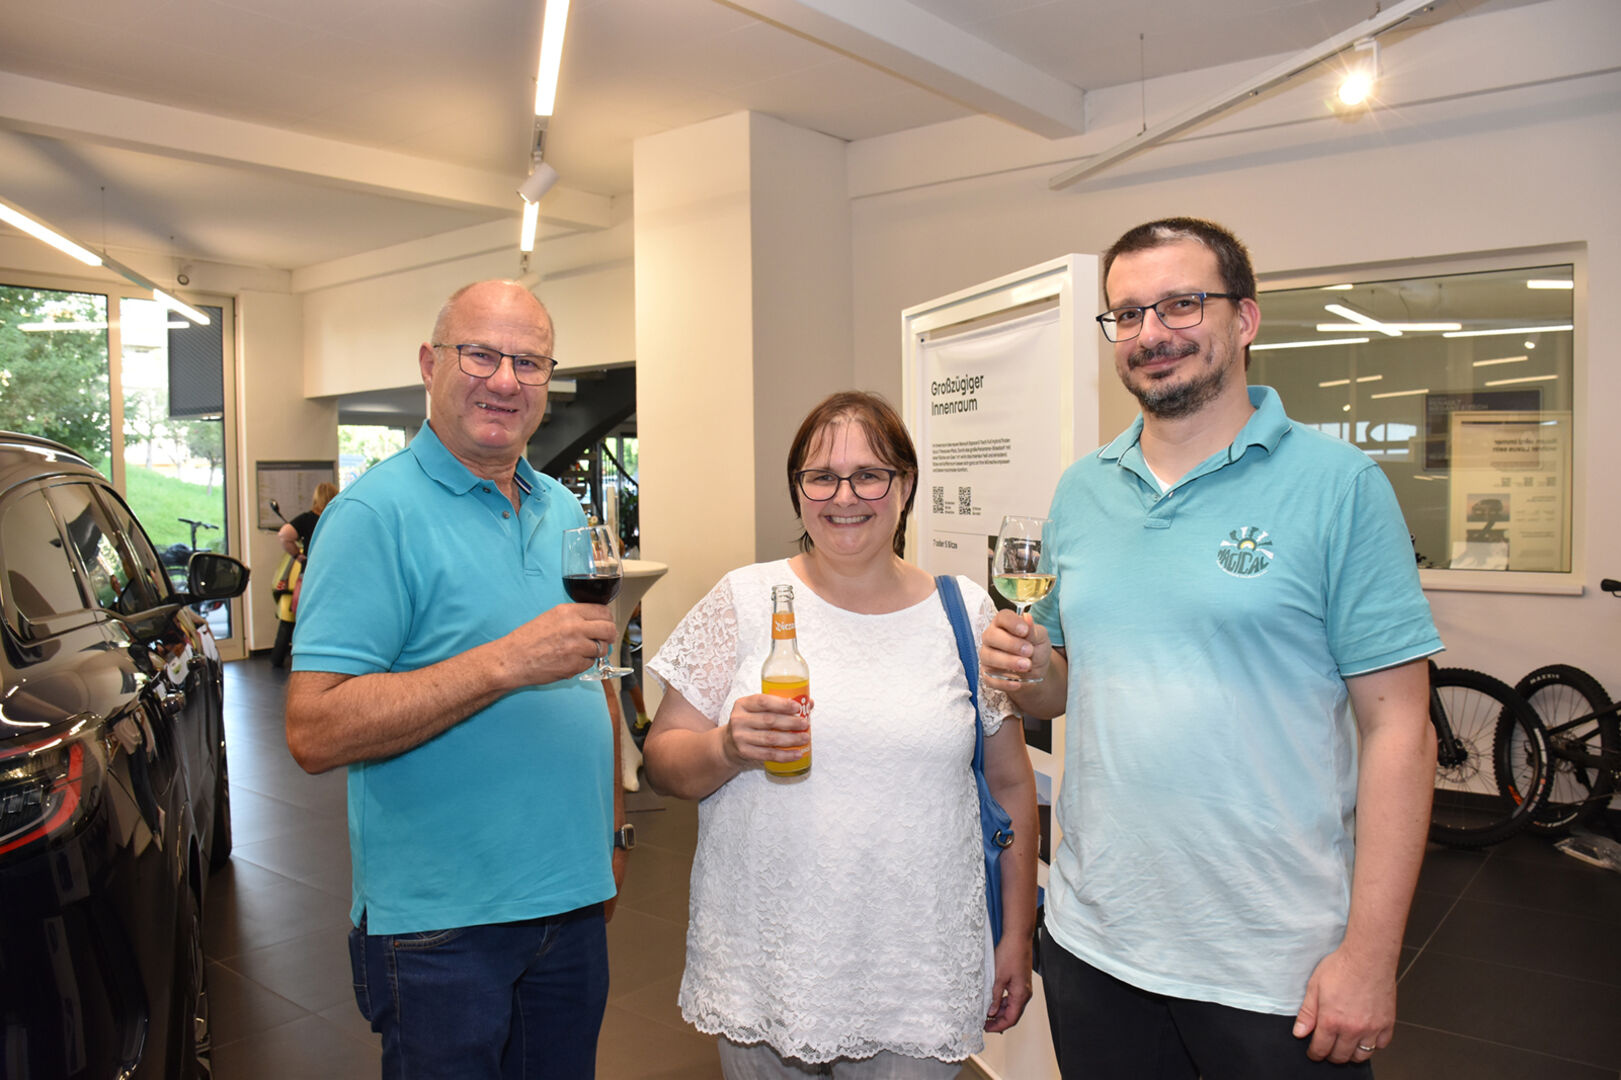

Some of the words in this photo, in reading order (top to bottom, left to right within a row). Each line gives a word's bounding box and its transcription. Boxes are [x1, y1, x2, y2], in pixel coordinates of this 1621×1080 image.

[931, 374, 984, 396] Großzügiger
[931, 398, 977, 416] Innenraum
[1217, 549, 1269, 575] MAGICAL
